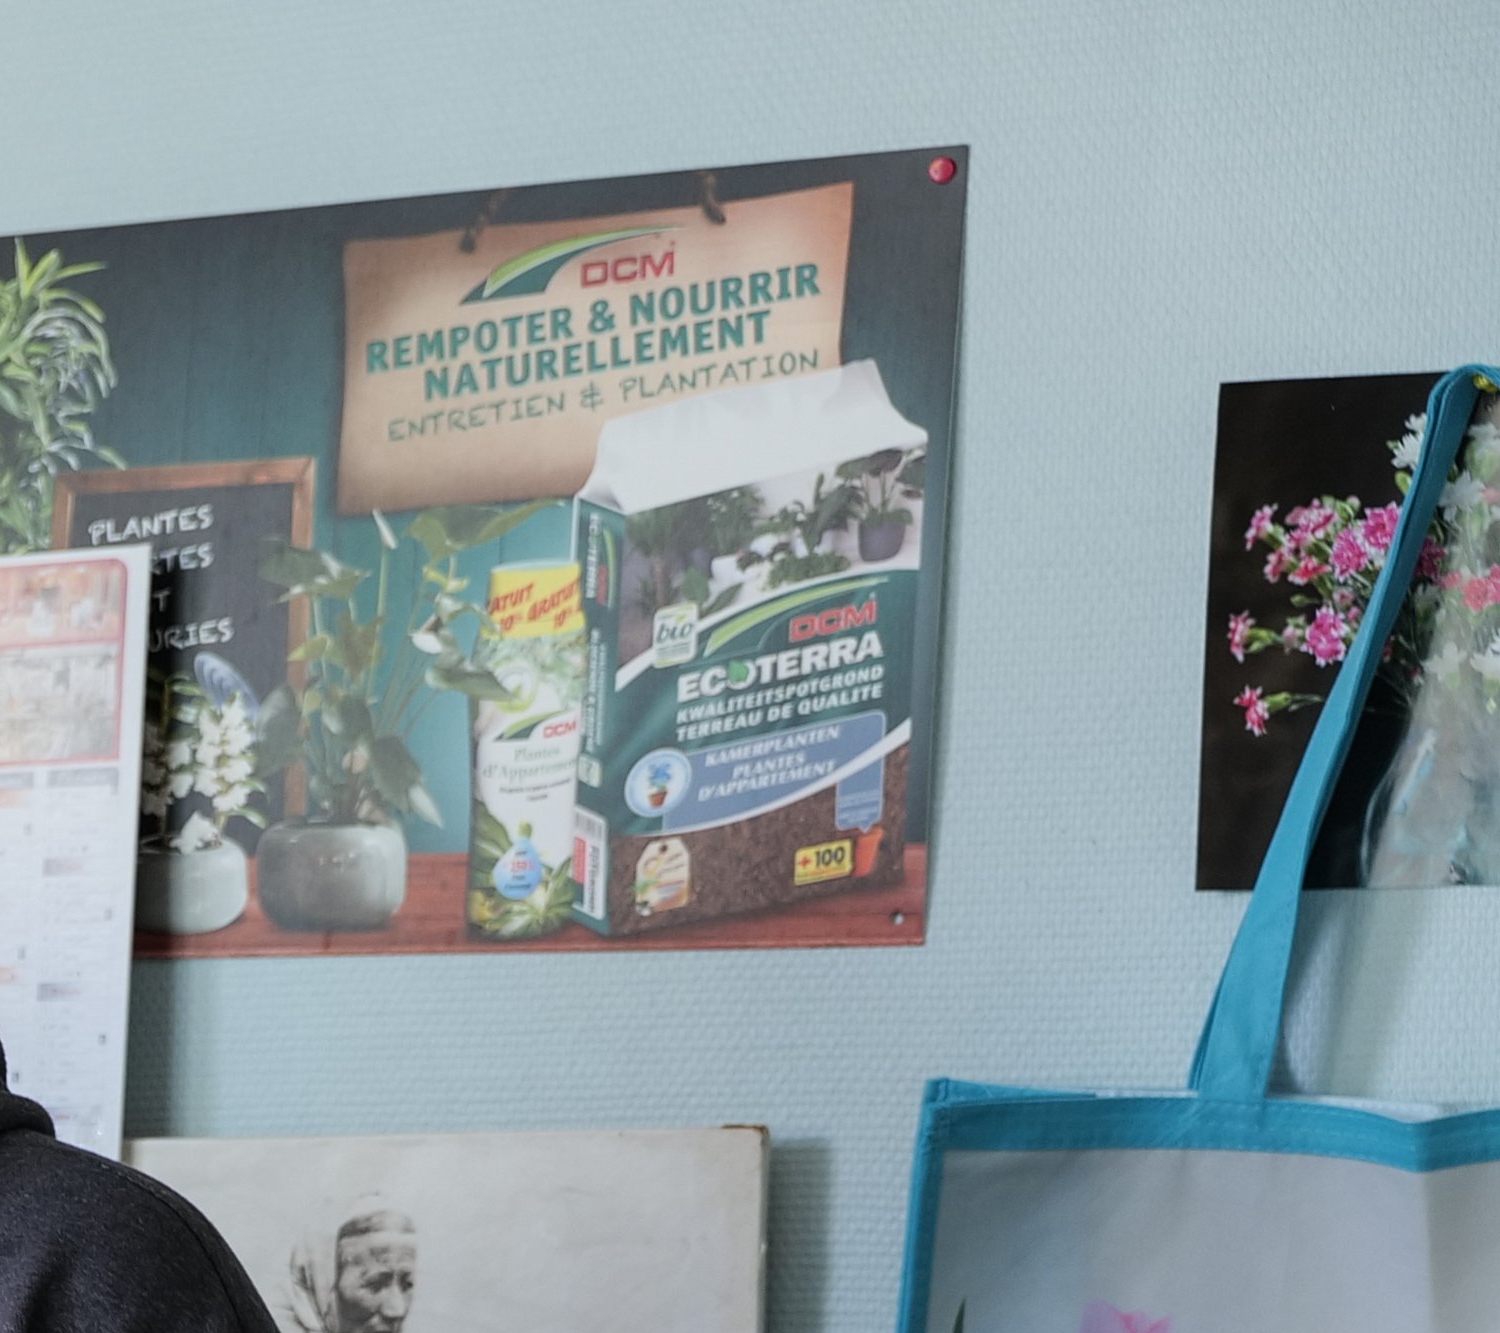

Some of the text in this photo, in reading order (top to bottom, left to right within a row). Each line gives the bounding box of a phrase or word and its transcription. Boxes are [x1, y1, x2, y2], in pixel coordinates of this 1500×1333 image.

[580, 250, 676, 289] DCM
[365, 262, 821, 376] REMPOTER & NOURRIR
[423, 309, 772, 403] NATURELLEMENT
[387, 390, 567, 443] ENTRETIEN
[618, 347, 820, 403] PLANTATION
[87, 503, 216, 547] PLANTES
[655, 613, 694, 644] bio
[788, 598, 878, 643] DCM
[676, 630, 885, 703] ECOTERRA
[676, 663, 885, 725] KWALITEITSPOTGROND
[675, 710, 764, 743] TERREAU
[767, 701, 793, 723] DE
[704, 724, 841, 768] KAMERPLANTEN
[732, 751, 807, 780] PLANTES
[698, 760, 836, 803] D'APPARTEMENT
